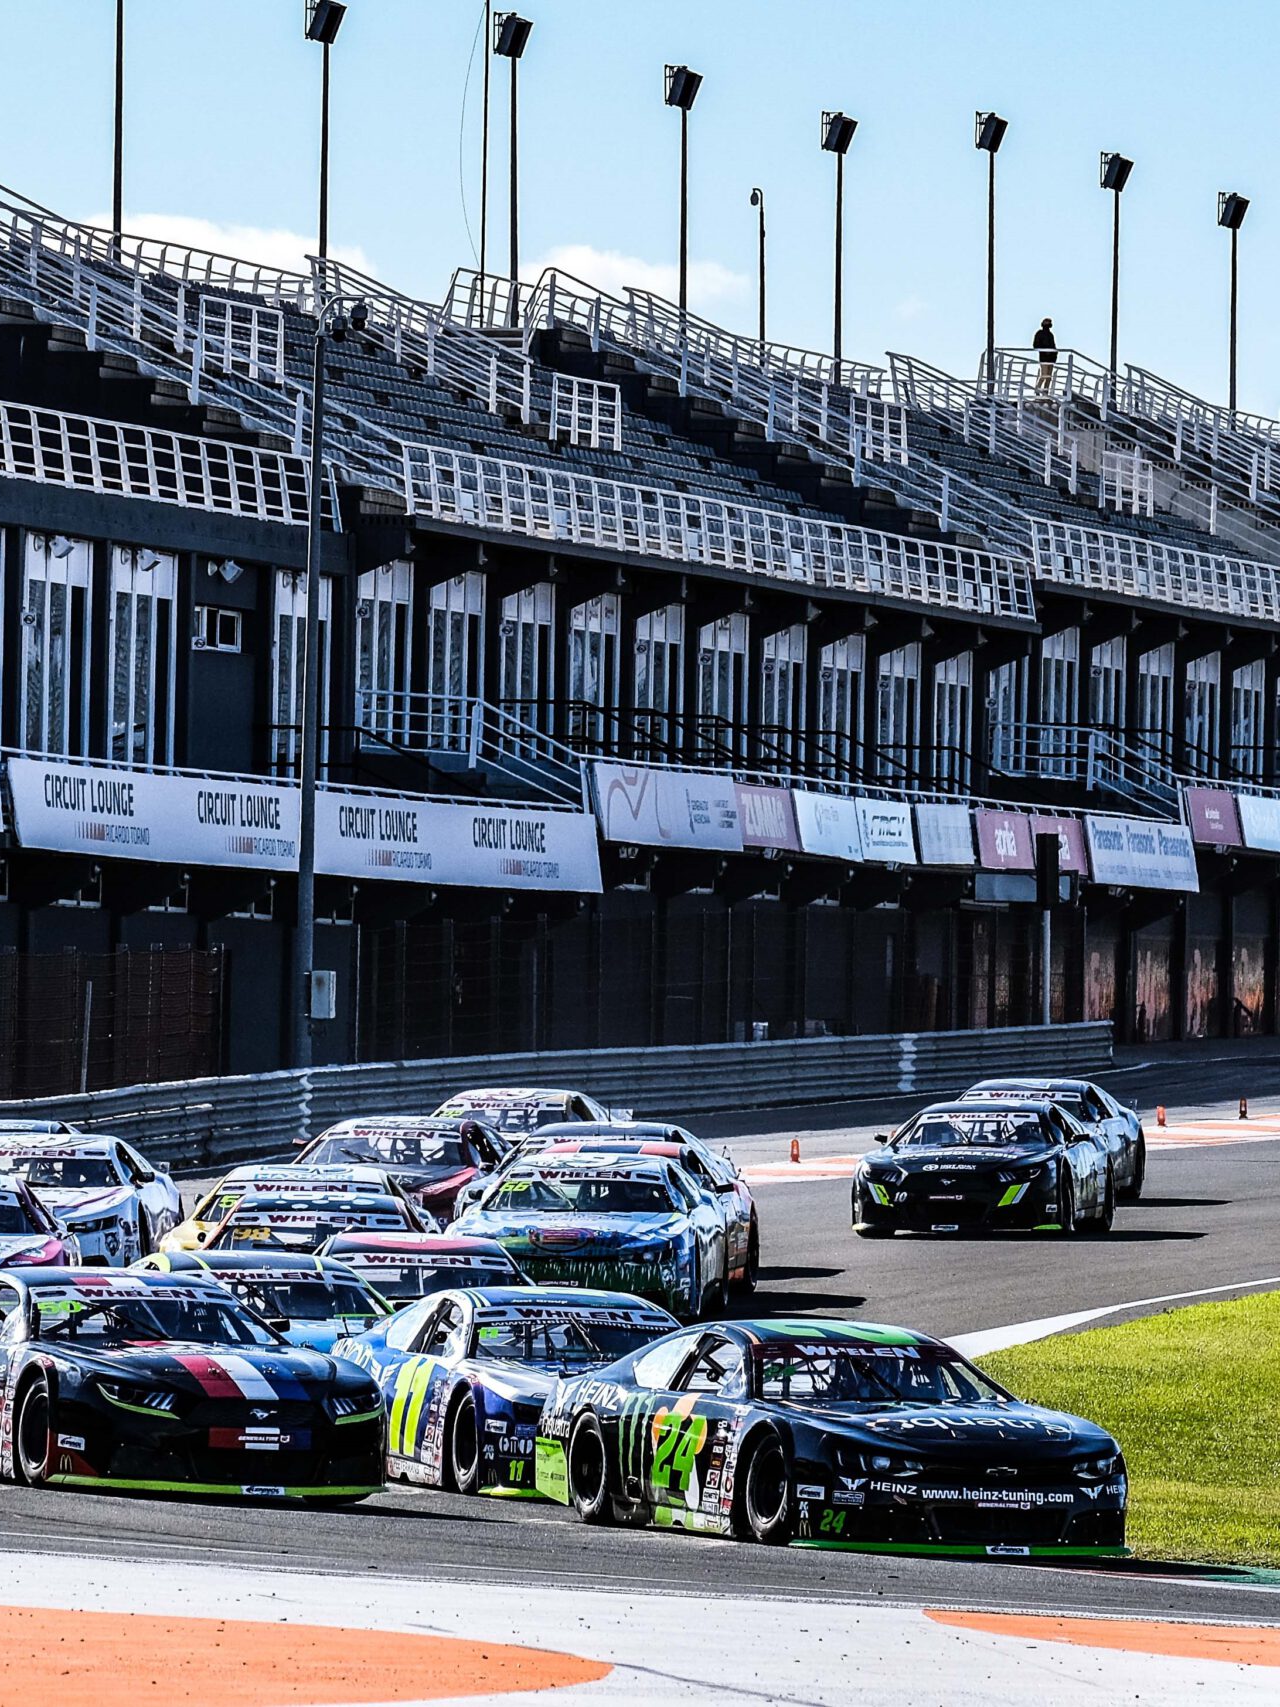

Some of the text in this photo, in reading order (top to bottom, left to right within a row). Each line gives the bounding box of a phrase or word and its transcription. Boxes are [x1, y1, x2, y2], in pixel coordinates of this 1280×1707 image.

[44, 774, 134, 817] CIRCUIT LOUNGE
[197, 790, 281, 830] CIRCUIT LOUNGE
[339, 805, 418, 843] CIRCUIT LOUNGE
[472, 817, 546, 853] CIRCUIT LOUNGE
[1091, 821, 1123, 850] Panasonic
[1126, 825, 1155, 854] Panasonic
[1158, 829, 1190, 858] Panasonic
[989, 1091, 1056, 1100] WHELEN
[353, 1130, 435, 1139] WHELEN
[539, 1171, 632, 1179] WHELEN
[254, 1184, 348, 1192] WHELEN
[499, 1182, 531, 1191] 66
[894, 1192, 908, 1203] 10
[268, 1215, 366, 1225] WHELEN
[364, 1257, 471, 1266] WHELEN
[211, 1272, 324, 1281] WHELEN
[74, 1288, 198, 1299] WHELEN
[38, 1301, 82, 1315] 50
[515, 1308, 633, 1322] WHELEN
[794, 1344, 919, 1358] WHELEN
[576, 1379, 619, 1411] HEINZ
[389, 1356, 436, 1457] 11
[652, 1412, 707, 1491] 24
[509, 1460, 524, 1481] 11
[871, 1481, 917, 1495] HEINZ
[922, 1487, 1074, 1505] www.heinz-tuning.com
[820, 1509, 846, 1533] 24
